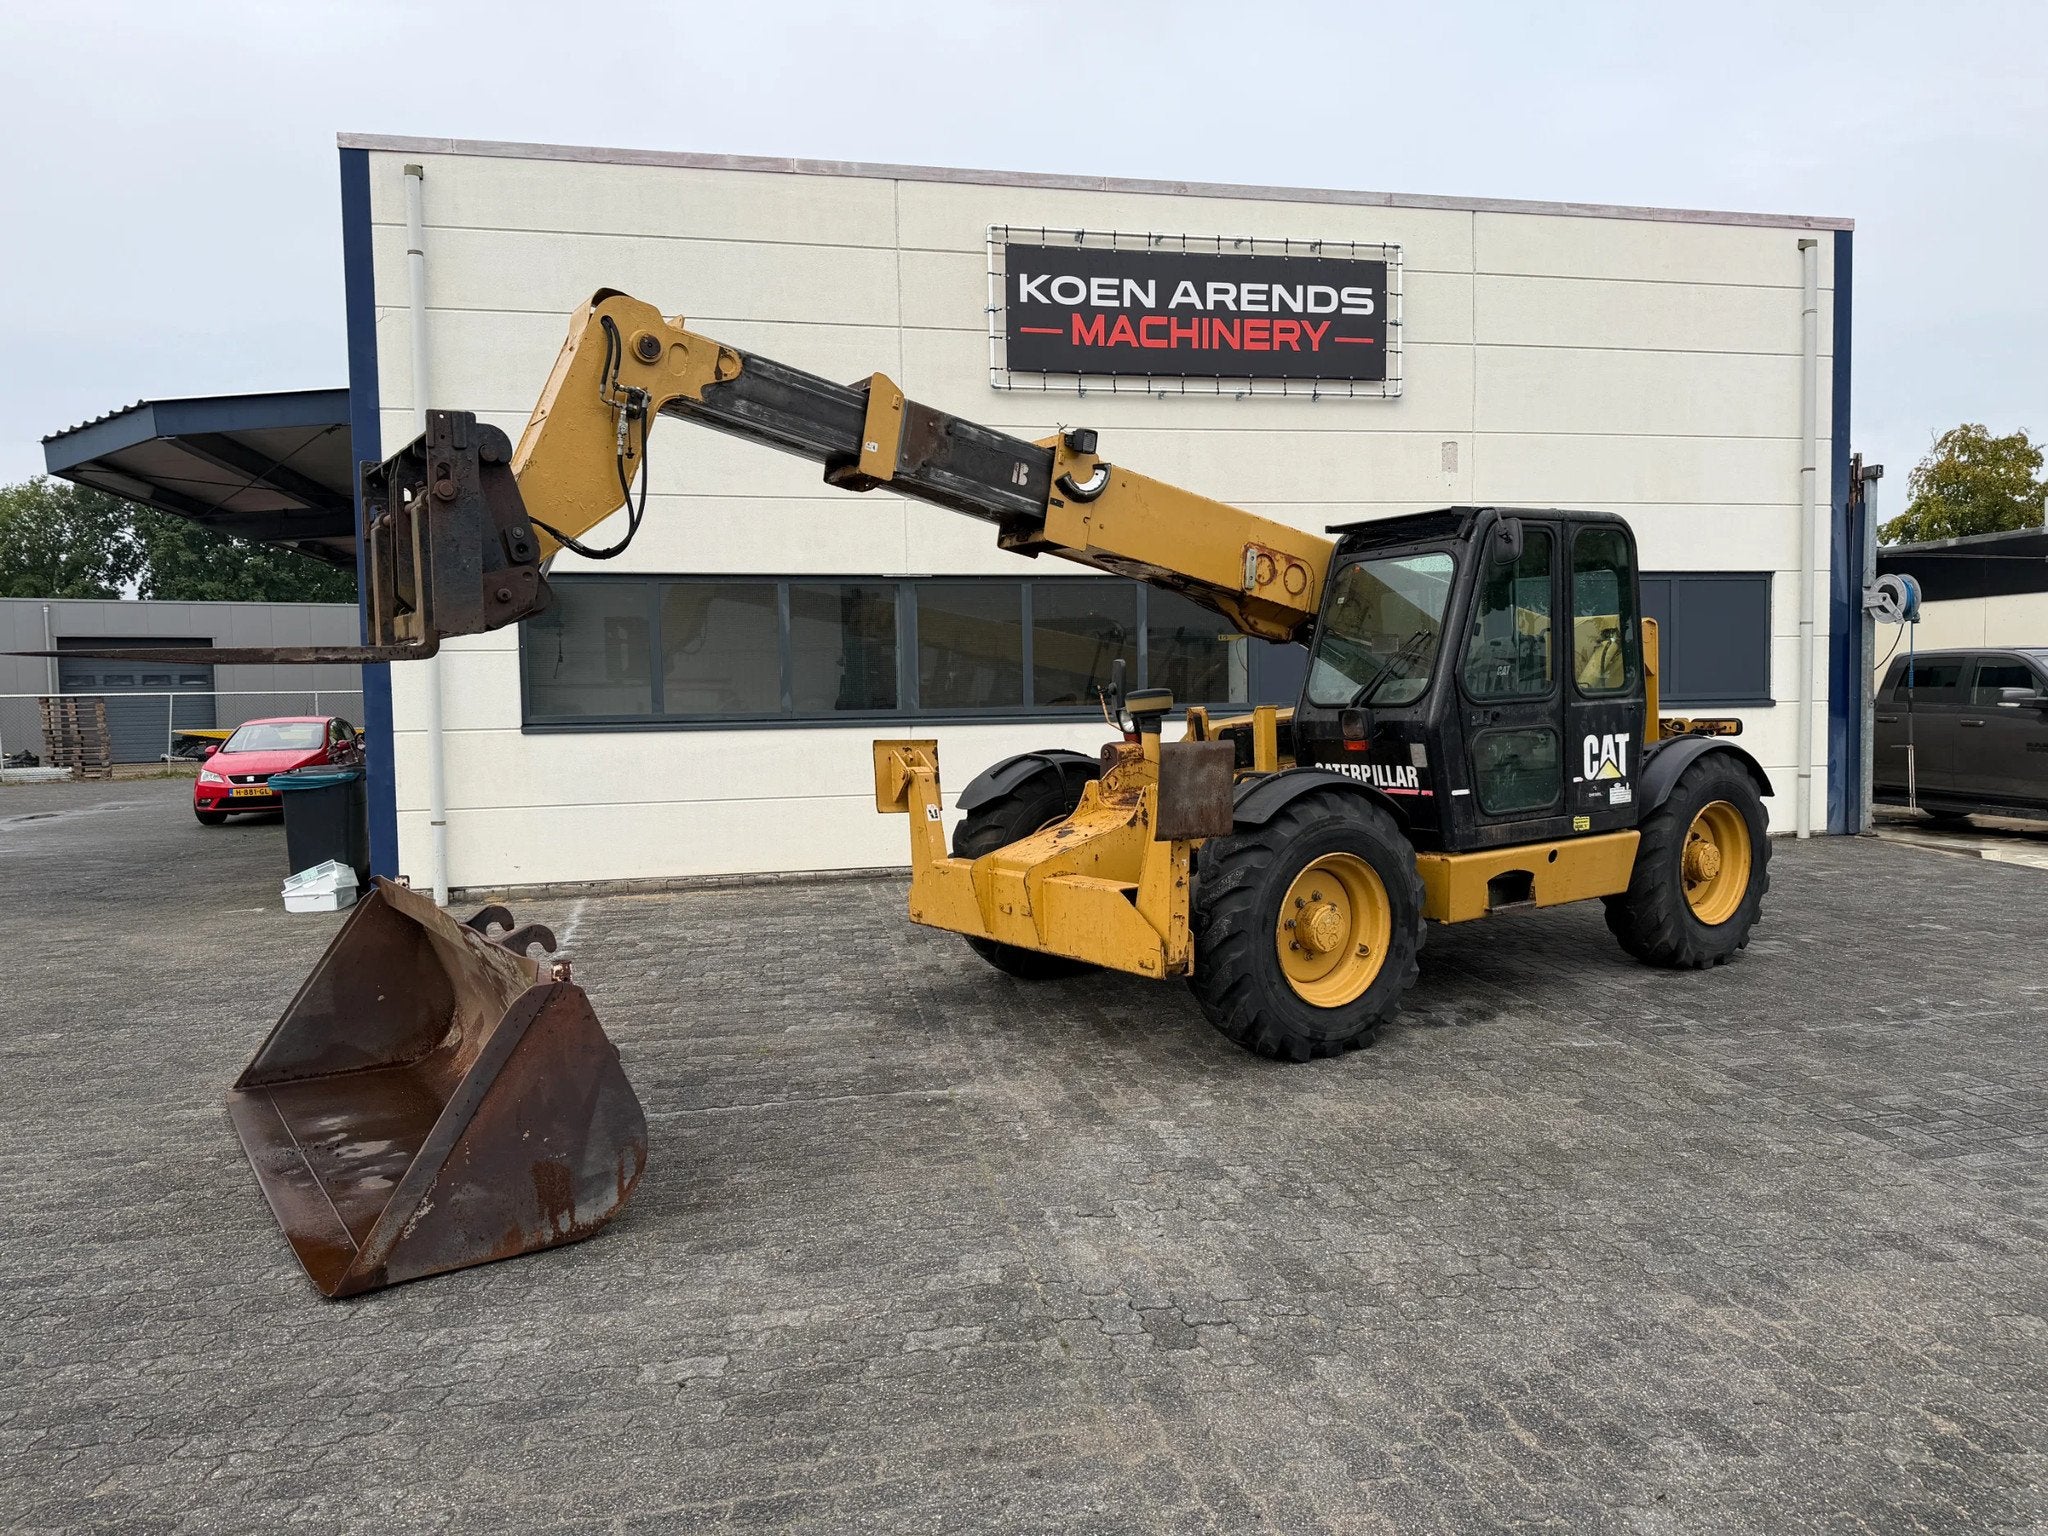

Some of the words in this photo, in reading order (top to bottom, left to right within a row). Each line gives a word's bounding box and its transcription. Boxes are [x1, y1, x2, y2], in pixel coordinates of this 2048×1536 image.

[1019, 273, 1156, 309] KOEN
[1167, 280, 1375, 316] ARENDS
[1071, 313, 1330, 352] MACHINERY
[1314, 762, 1419, 788] ERPILLAR
[1583, 733, 1630, 780] CAT
